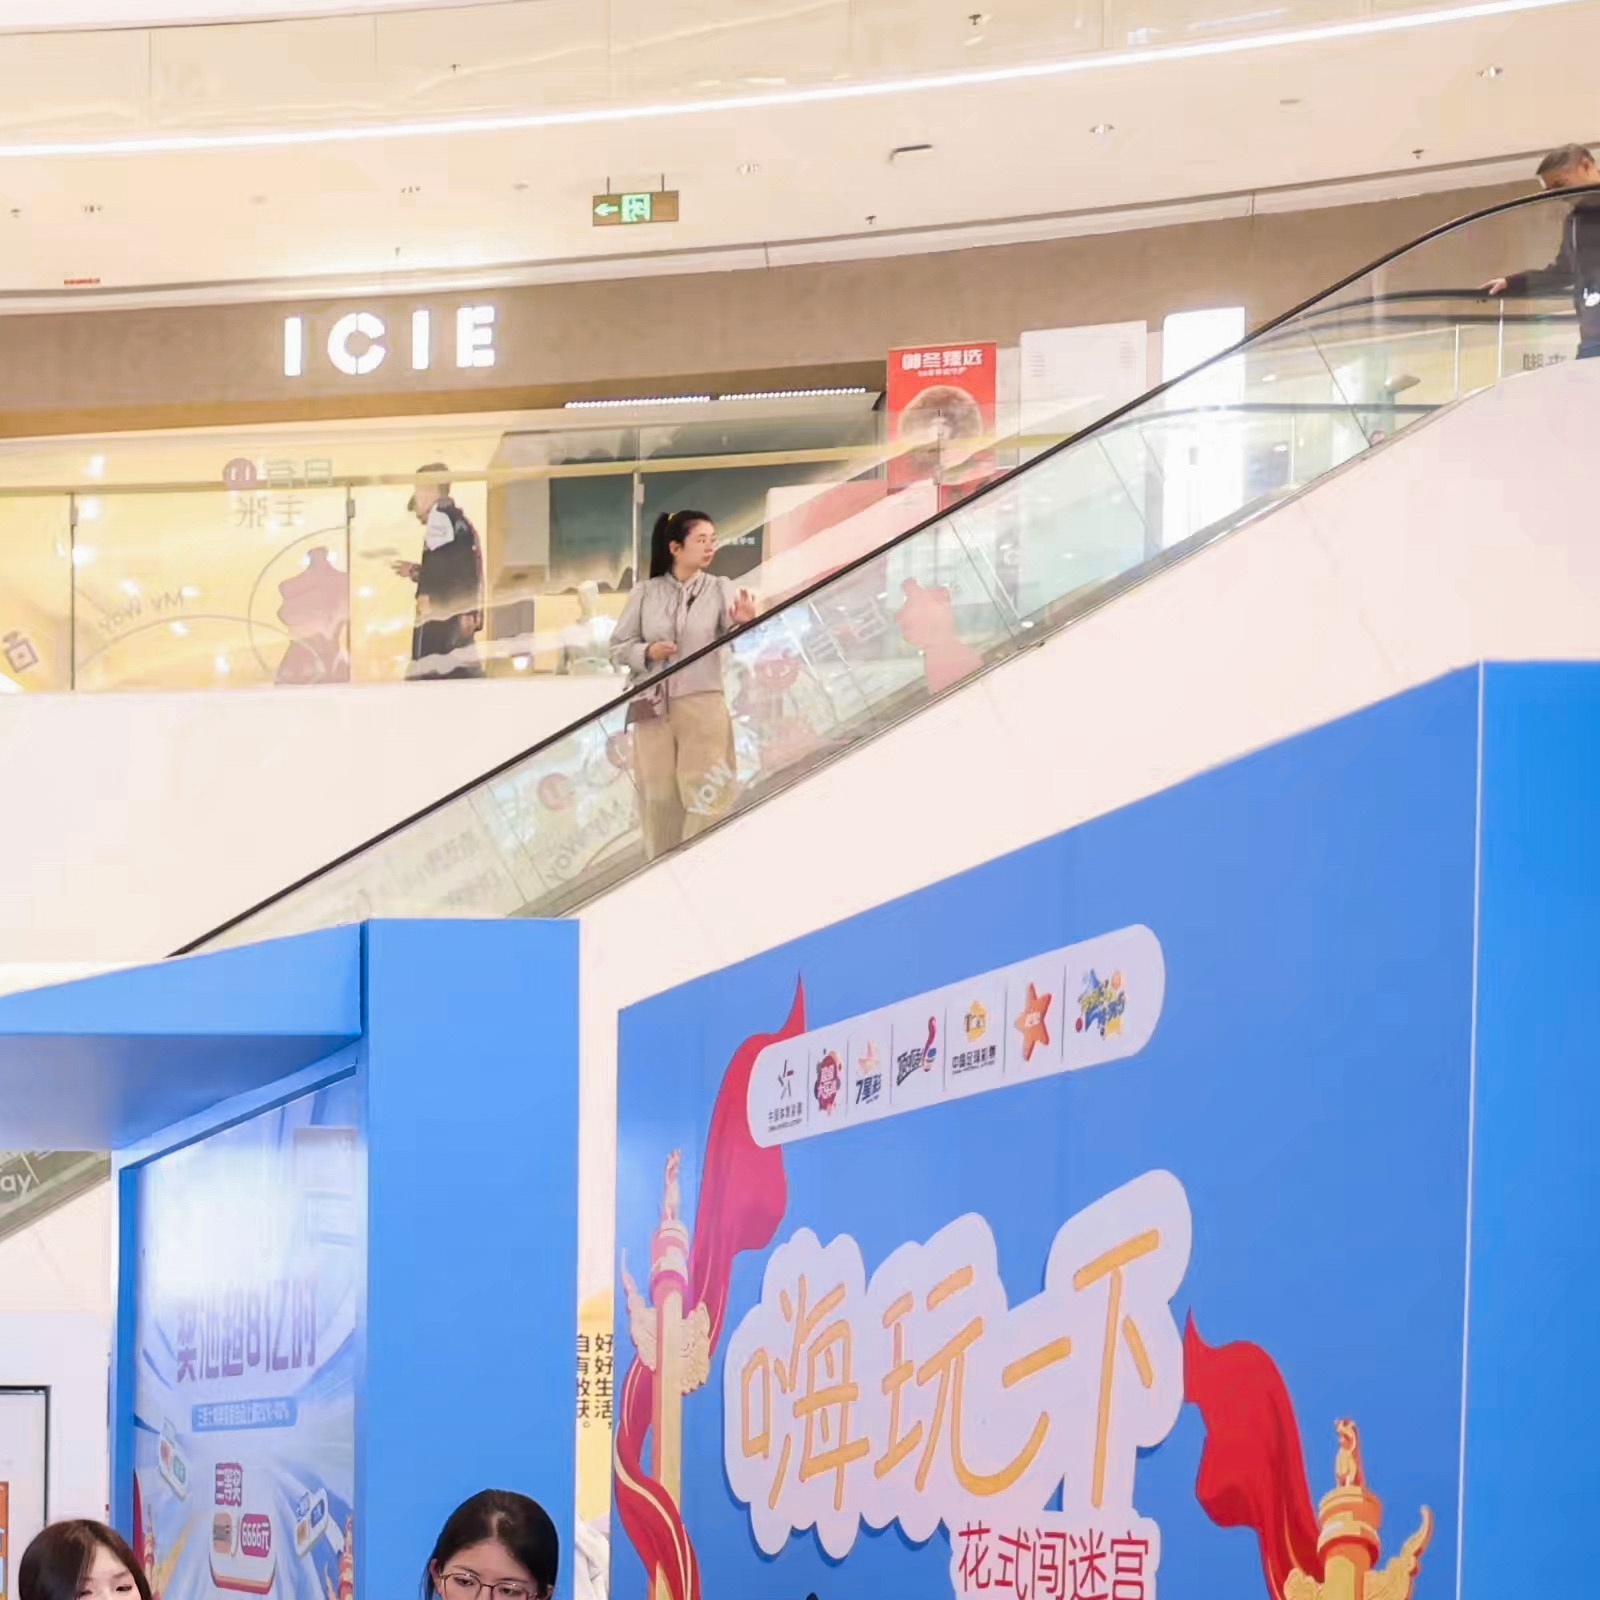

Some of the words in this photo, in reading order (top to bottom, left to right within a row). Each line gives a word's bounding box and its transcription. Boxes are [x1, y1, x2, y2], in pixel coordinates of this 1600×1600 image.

[284, 306, 495, 376] ICIE
[740, 1228, 1161, 1513] 嗨玩一下
